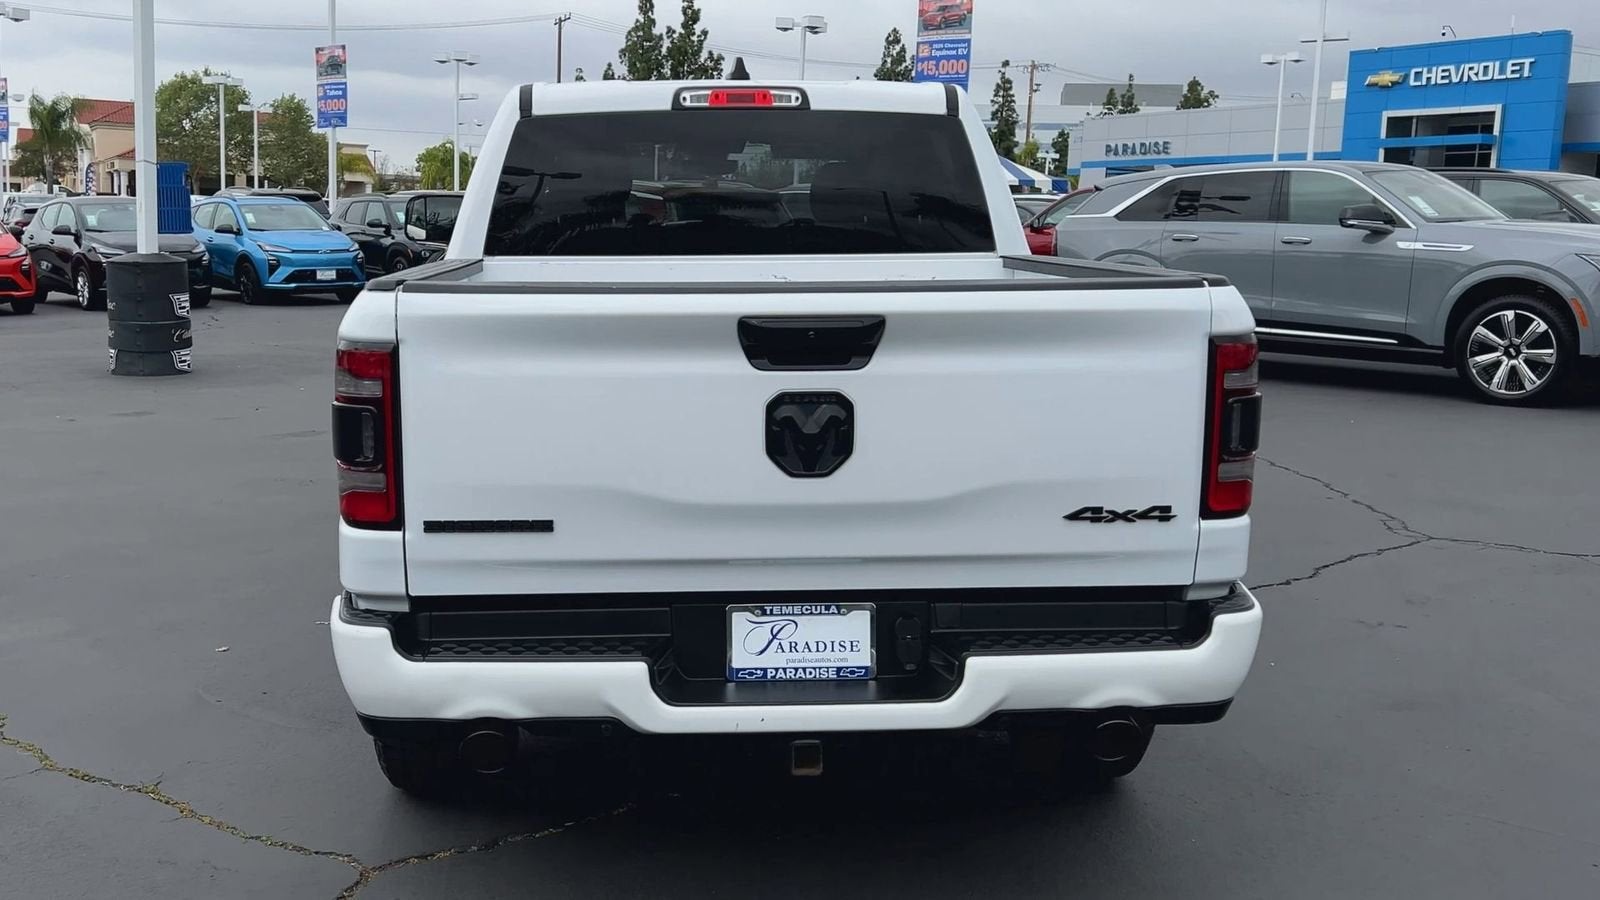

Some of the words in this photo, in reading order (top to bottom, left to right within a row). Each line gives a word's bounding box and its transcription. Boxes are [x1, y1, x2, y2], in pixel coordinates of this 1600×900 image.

[931, 49, 957, 57] Equinox
[917, 59, 968, 77] $15,000
[1409, 58, 1535, 86] CHEVROLET
[1105, 141, 1171, 157] PARADISE
[1062, 505, 1178, 523] 4x4
[764, 605, 839, 615] TEMECULA
[785, 656, 849, 665] paradiseautos.com
[766, 668, 838, 679] PARADISE
